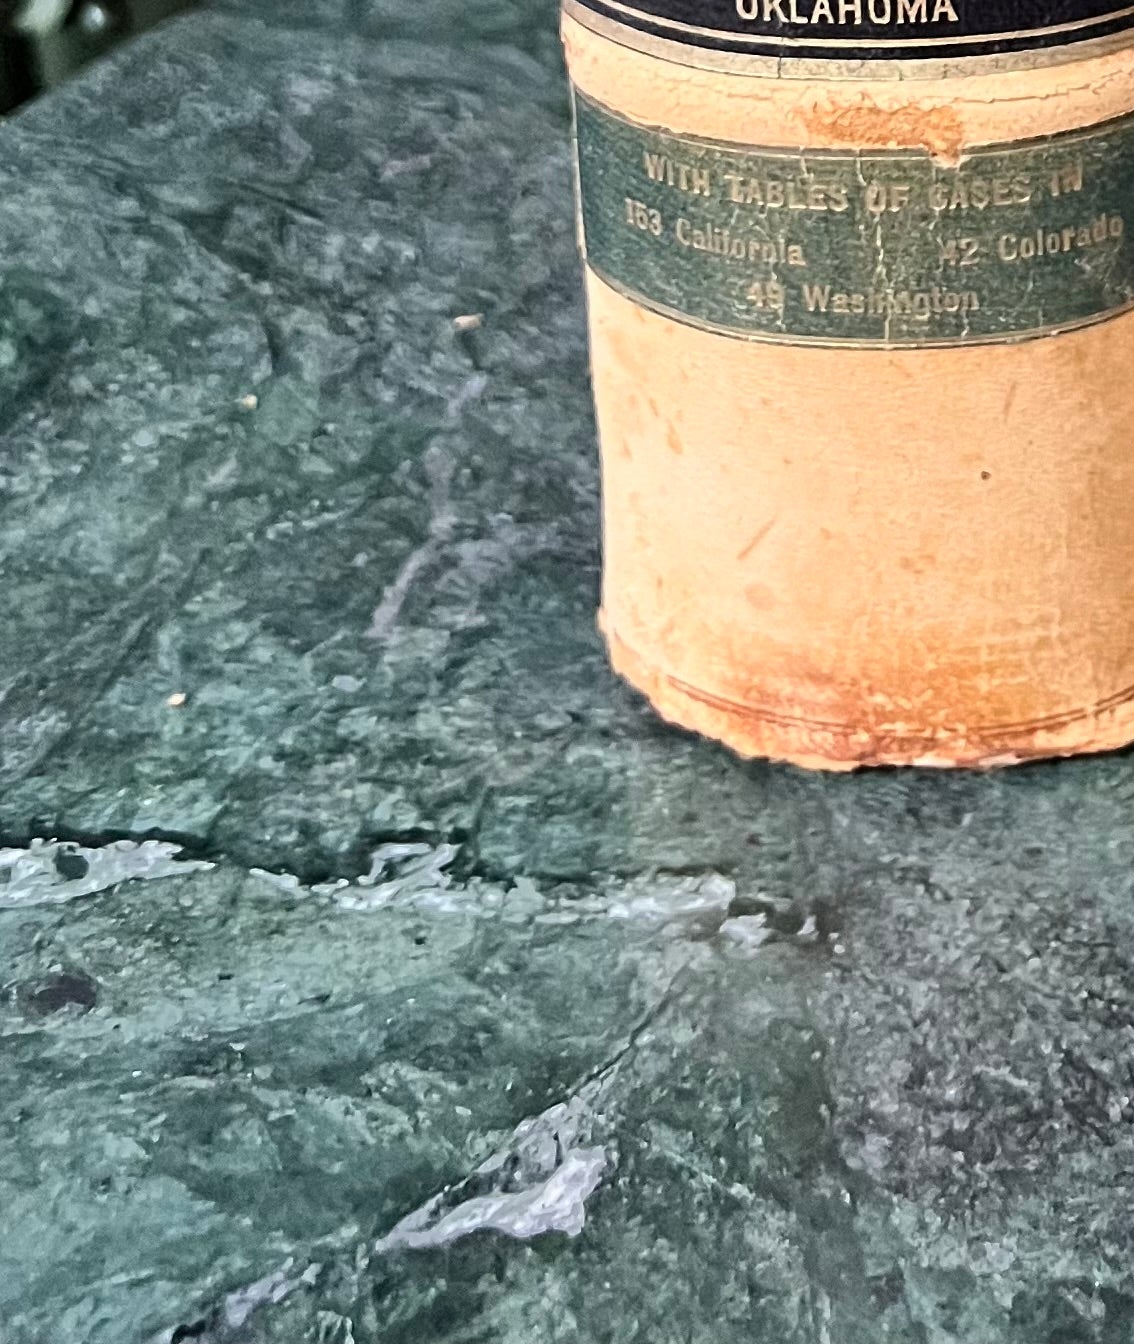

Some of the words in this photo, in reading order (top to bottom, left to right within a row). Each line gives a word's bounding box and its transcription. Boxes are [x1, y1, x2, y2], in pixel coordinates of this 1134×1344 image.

[642, 151, 712, 198] WITH
[723, 174, 849, 212] TABLES
[864, 182, 910, 213] OF
[928, 175, 1033, 212] CASES
[675, 216, 808, 267] California
[999, 212, 1126, 262] Colorado
